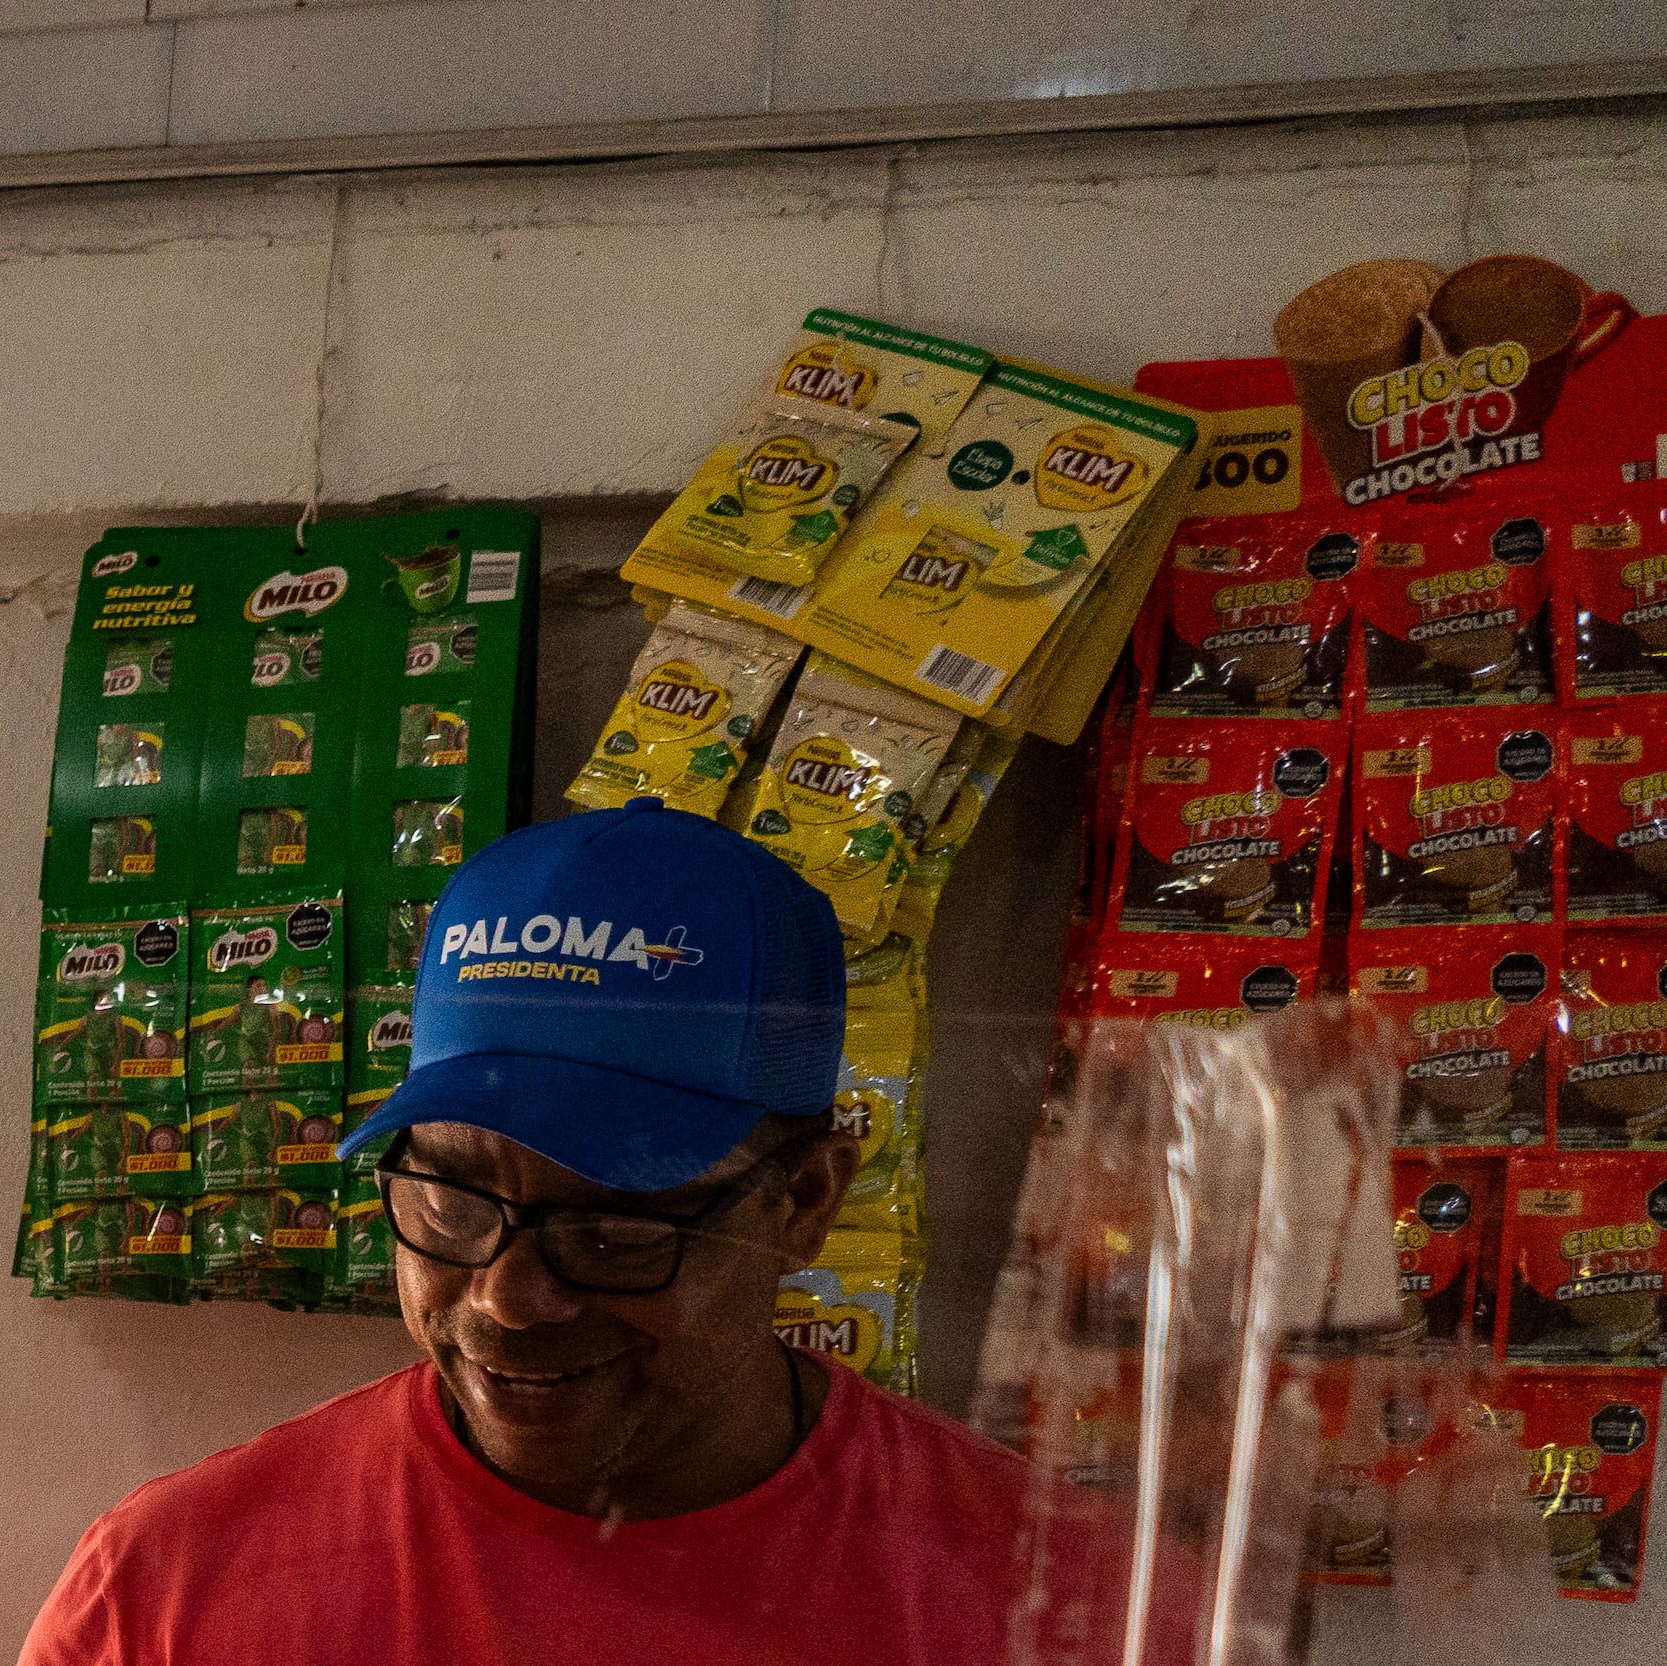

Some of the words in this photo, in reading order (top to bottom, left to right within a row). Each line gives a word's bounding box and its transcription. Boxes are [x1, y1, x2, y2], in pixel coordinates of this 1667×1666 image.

[1348, 341, 1529, 429] CHOCO
[1371, 391, 1516, 467] LISTO
[749, 456, 825, 491] KLIM
[1044, 445, 1132, 494] KLIM
[1342, 431, 1544, 509] CHOCOLATE
[104, 584, 167, 600] Sabor
[177, 583, 194, 600] y
[257, 580, 339, 613] MILO
[92, 611, 196, 630] nutritiva
[1408, 609, 1517, 641] CHOCOLATE
[1203, 622, 1312, 650] CHOCOLATE
[640, 682, 718, 720] KLIM
[1170, 840, 1281, 866] CHOCOLATE
[1408, 826, 1518, 859] CHOCOLATE
[216, 939, 271, 961] MILO
[439, 913, 652, 971] PALOMA
[458, 963, 601, 987] PRESIDENTA
[1405, 1051, 1510, 1079] CHOCOLATE
[129, 1158, 179, 1171] $1.000
[279, 1149, 330, 1162] $1.000
[132, 1240, 180, 1253] $1.000
[1555, 1273, 1664, 1301] CHOCOLATE
